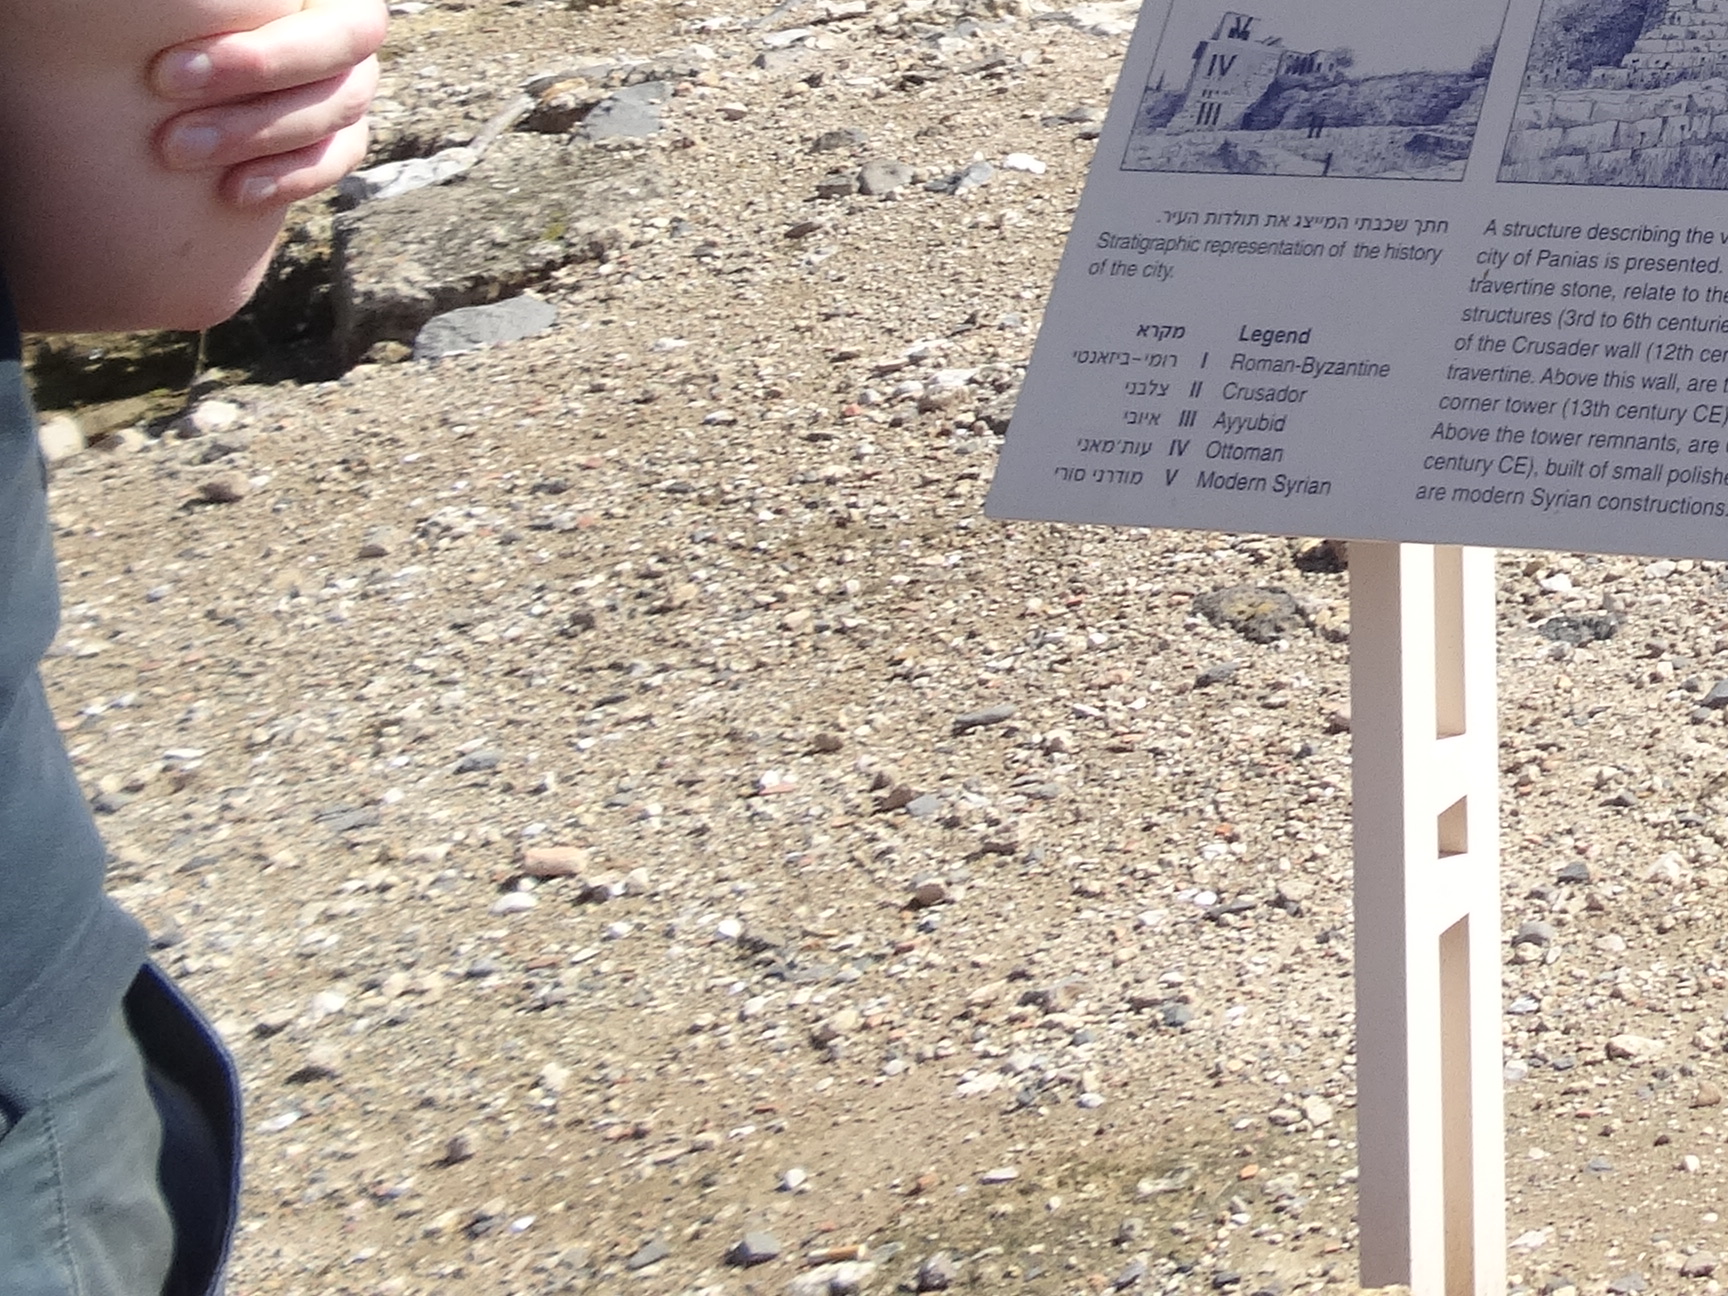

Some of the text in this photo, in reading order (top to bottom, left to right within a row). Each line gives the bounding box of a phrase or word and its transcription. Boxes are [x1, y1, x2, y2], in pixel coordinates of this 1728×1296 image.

[1202, 208, 1260, 227] תולדות
[1262, 213, 1291, 228] את
[1292, 214, 1350, 230] המייצג
[1353, 216, 1409, 233] שכבתי
[1413, 218, 1449, 237] חתך
[1482, 217, 1497, 236] A
[1501, 220, 1582, 240] structure
[1585, 222, 1681, 248] describing
[1684, 225, 1715, 245] the
[1094, 230, 1444, 266] Stratigraphic representation of the history
[1086, 257, 1175, 283] of the city.
[1475, 248, 1510, 270] city
[1512, 247, 1533, 266] of
[1534, 248, 1599, 269] Panias
[1602, 255, 1620, 270] is
[1622, 255, 1723, 275] presented.
[1459, 305, 1552, 326] structures
[1556, 308, 1596, 330] (3rd
[1598, 311, 1618, 329] to
[1621, 310, 1652, 330] 6th
[1134, 323, 1186, 342] מקרא
[1237, 323, 1313, 348] Legend
[1453, 332, 1474, 352] of
[1476, 334, 1507, 353] the
[1510, 334, 1600, 357] Crusader
[1603, 340, 1642, 359] wall
[1644, 341, 1694, 363] (12th
[1199, 350, 1210, 370] I
[1228, 351, 1391, 380] Roman-Byzantine
[1123, 378, 1171, 397] צלבני
[1187, 379, 1204, 399] II
[1445, 363, 1536, 384] travertine.
[1537, 366, 1599, 388] Above
[1602, 369, 1636, 389] this
[1640, 371, 1681, 393] wall,
[1685, 376, 1718, 393] are
[1221, 380, 1309, 404] Crusador
[1121, 409, 1162, 426] איובי
[1176, 408, 1198, 428] III
[1211, 410, 1288, 435] Ayyubid
[1437, 394, 1501, 413] corner
[1503, 395, 1558, 415] tower
[1560, 397, 1611, 420] (13th
[1614, 403, 1688, 427] century
[1167, 437, 1191, 457] IV
[1429, 421, 1491, 443] Above
[1494, 424, 1526, 444] the
[1529, 426, 1584, 447] tower
[1586, 432, 1681, 455] remnants,
[1686, 437, 1720, 455] are
[1204, 439, 1285, 463] Ottoman
[1053, 465, 1144, 486] מודרני סורי
[1164, 467, 1180, 487] V
[1422, 454, 1494, 477] century
[1496, 453, 1538, 480] CE),
[1543, 456, 1585, 478] built
[1587, 459, 1610, 479] of
[1610, 462, 1664, 482] small
[1195, 469, 1332, 499] Modern Syrian
[1414, 484, 1447, 502] are
[1450, 484, 1525, 505] modern
[1529, 486, 1592, 512] Syrian
